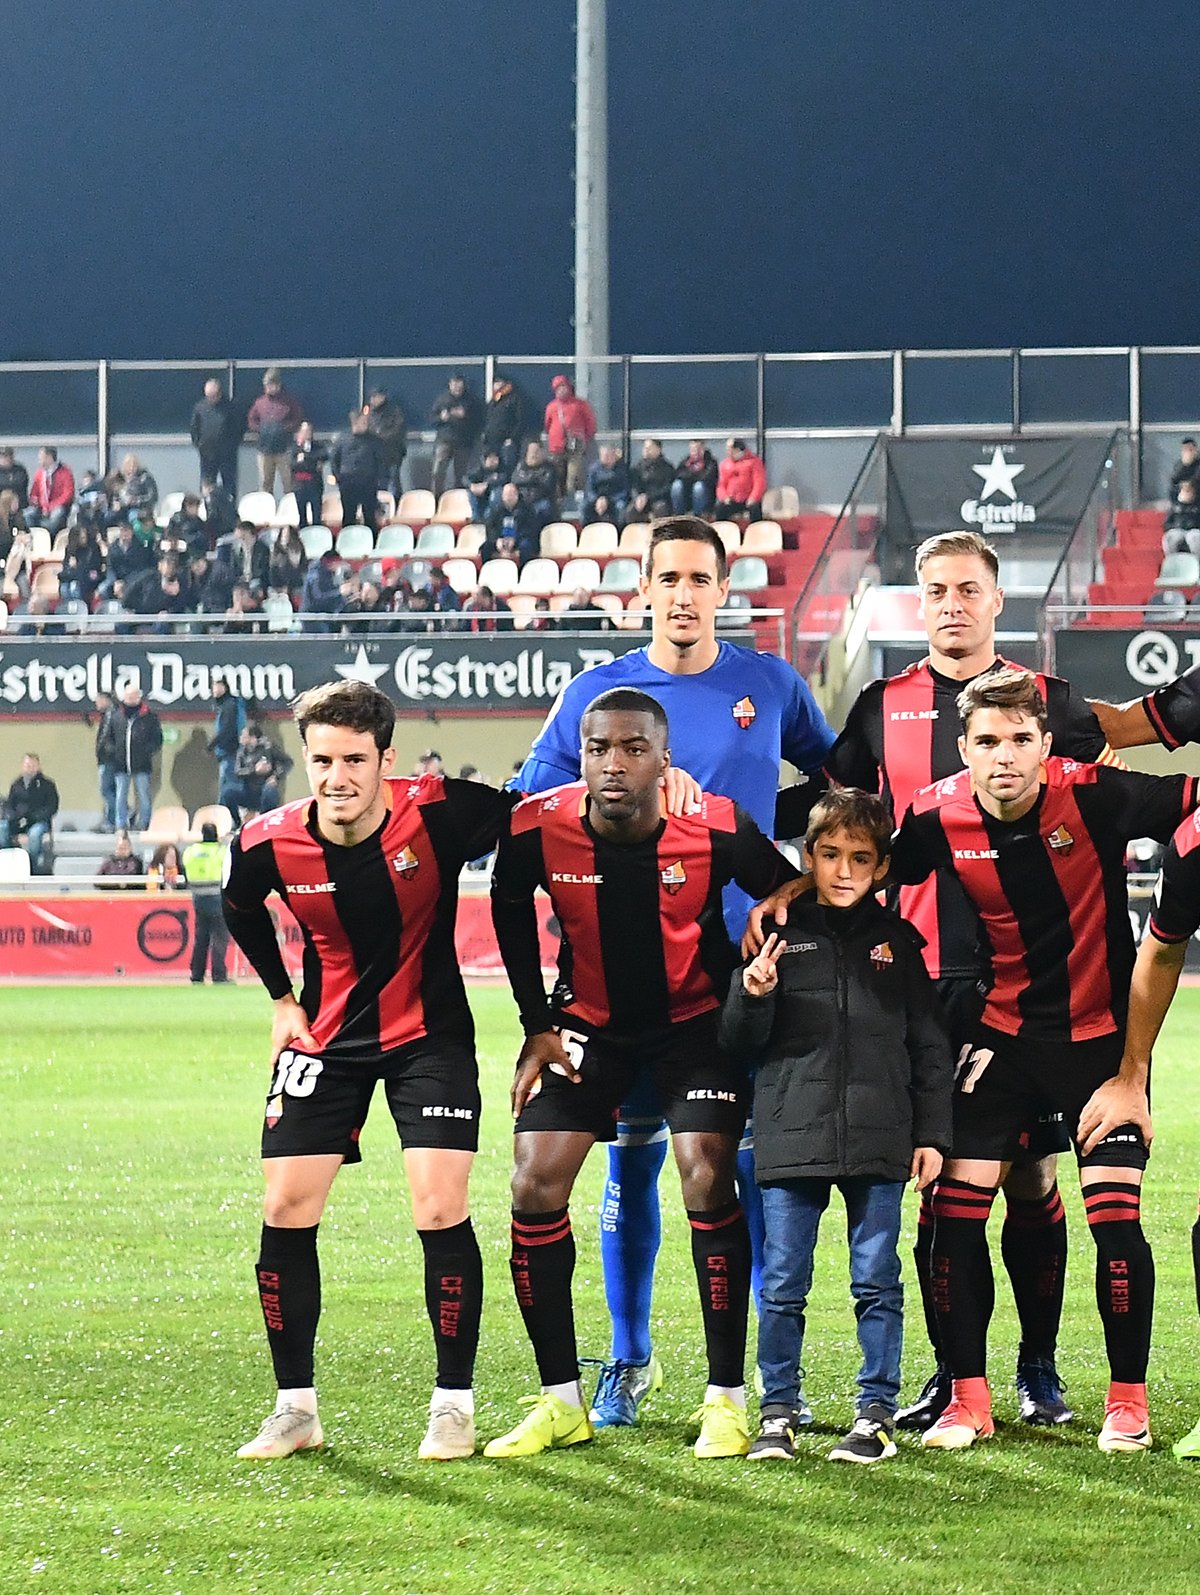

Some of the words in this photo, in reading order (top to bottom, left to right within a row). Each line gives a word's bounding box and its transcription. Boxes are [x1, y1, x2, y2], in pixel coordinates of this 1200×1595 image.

[0, 651, 143, 703] strella
[146, 651, 297, 704] Damm
[394, 644, 573, 700] Estrella
[891, 710, 939, 720] KELME
[955, 849, 999, 859] KELME
[553, 873, 603, 884] KELME
[286, 882, 337, 893] KELME
[549, 1025, 589, 1076] 5
[687, 1089, 737, 1102] KELME
[422, 1106, 473, 1120] KELME
[1039, 1113, 1063, 1123] LME
[608, 1181, 621, 1198] CF
[602, 1199, 621, 1232] REUS
[708, 1256, 727, 1270] CF
[1109, 1260, 1128, 1274] CF
[261, 1271, 280, 1289] CF
[441, 1277, 462, 1294] CF
[710, 1276, 729, 1310] REUS
[1111, 1279, 1129, 1313] REUS
[262, 1292, 284, 1331] REUS
[441, 1301, 461, 1337] REUS
